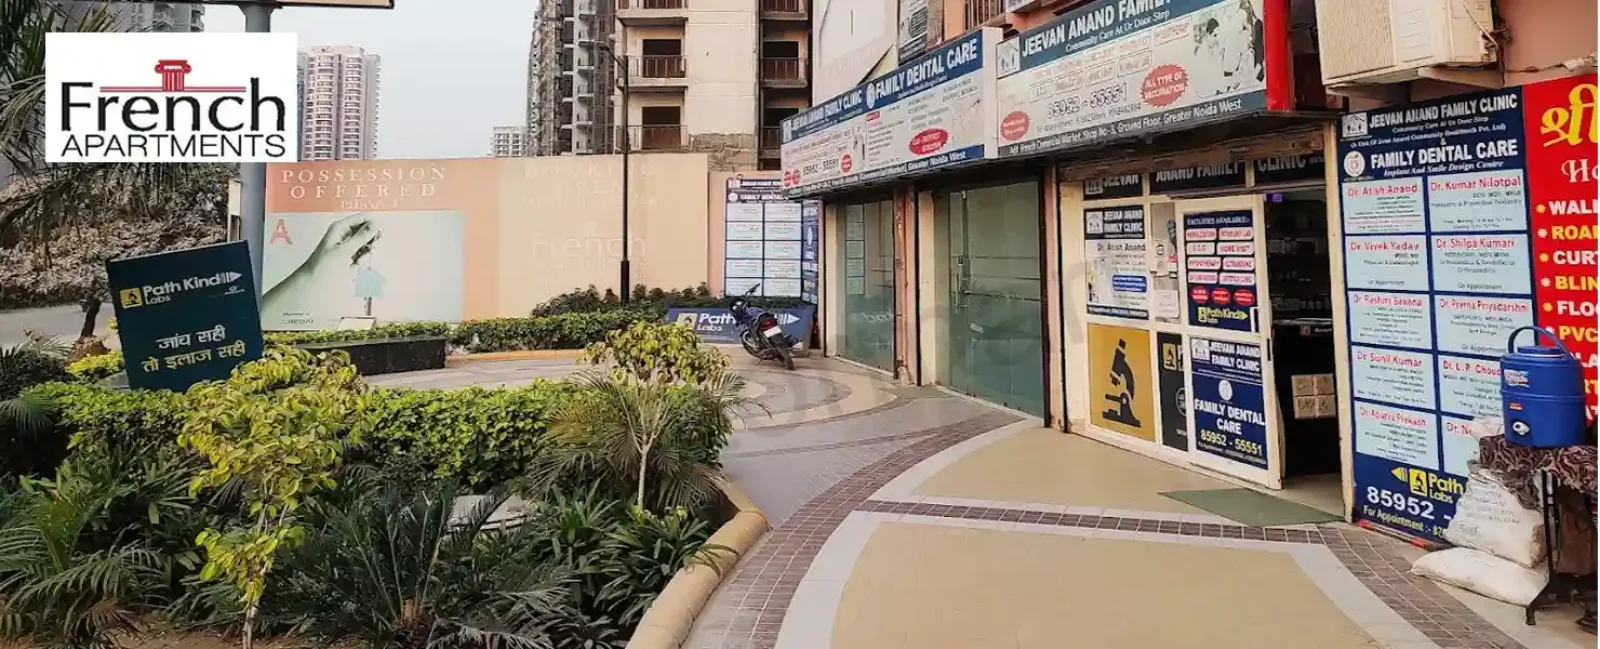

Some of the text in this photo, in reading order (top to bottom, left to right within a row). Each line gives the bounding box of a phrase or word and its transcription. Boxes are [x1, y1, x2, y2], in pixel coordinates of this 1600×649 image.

[1022, 25, 1066, 57] JEEVAN
[1068, 5, 1115, 40] ANAND
[876, 71, 906, 99] FAMILY
[907, 54, 945, 85] DENTAL
[947, 38, 978, 69] CARE
[1163, 110, 1192, 125] Greater
[1193, 103, 1217, 118] Noida
[1220, 98, 1242, 113] West
[1369, 93, 1518, 129] JEEVAN ANAND FAMILY CLINIC
[1371, 139, 1518, 169] FAMILY DENTAL CARE
[282, 167, 446, 183] POSSESSION
[1445, 179, 1477, 190] Kumar
[290, 183, 435, 199] OFFERED
[1387, 183, 1418, 194] Anand
[269, 218, 293, 245] A
[1365, 240, 1388, 251] Vivek
[1390, 241, 1419, 252] Yadav
[1450, 237, 1477, 250] Shilpa
[1479, 238, 1514, 248] Kumari
[143, 281, 181, 298] Path
[183, 274, 221, 291] Kind
[145, 294, 171, 305] Labs
[1557, 300, 1598, 316] FLO
[155, 324, 226, 350] जांच सही
[696, 323, 723, 333] Labs
[1559, 325, 1598, 342] PVC
[141, 340, 246, 373] तो इलाज सही
[1236, 357, 1260, 372] CLINIC
[1370, 352, 1391, 363] Sunil
[1394, 355, 1422, 367] Kumar
[1194, 398, 1266, 425] FAMILY DENTAL
[1216, 418, 1242, 435] CARE
[1200, 429, 1227, 446] 85952
[1235, 438, 1263, 456] 55551
[1428, 473, 1464, 495] Path
[1366, 486, 1435, 520] 85952
[1429, 489, 1453, 504] Labs
[1363, 504, 1376, 516] For
[1377, 507, 1424, 532] Appointment
